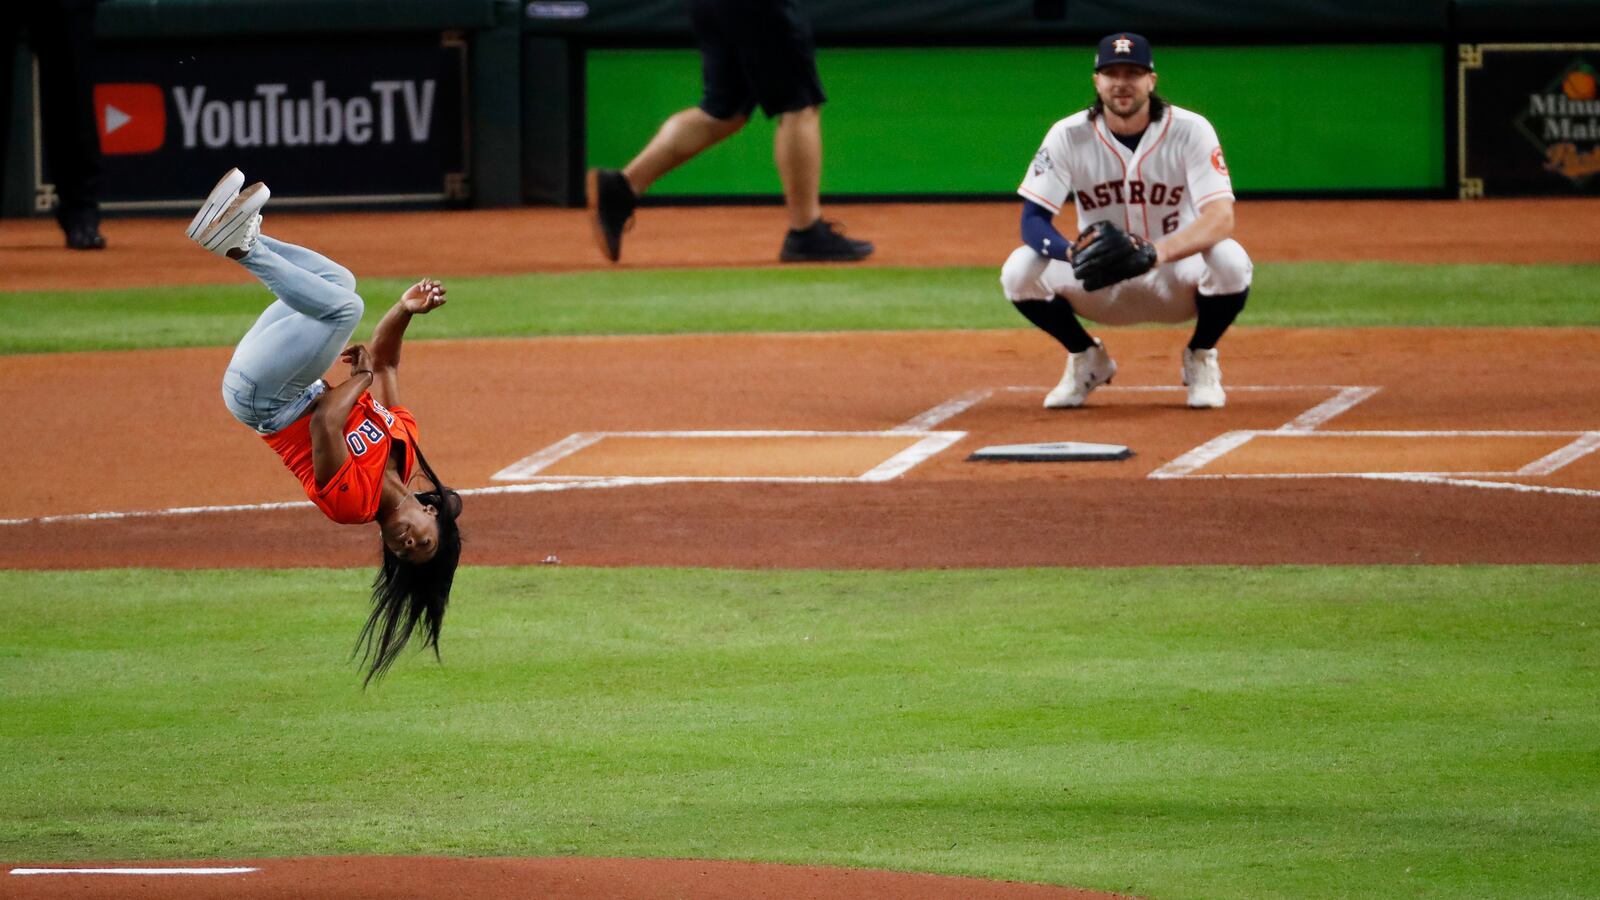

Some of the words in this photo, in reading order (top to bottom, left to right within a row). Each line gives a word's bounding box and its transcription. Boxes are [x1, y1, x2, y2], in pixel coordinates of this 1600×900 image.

[1543, 118, 1600, 139] Mai
[1077, 180, 1184, 212] ASTROS
[1162, 211, 1179, 235] 6
